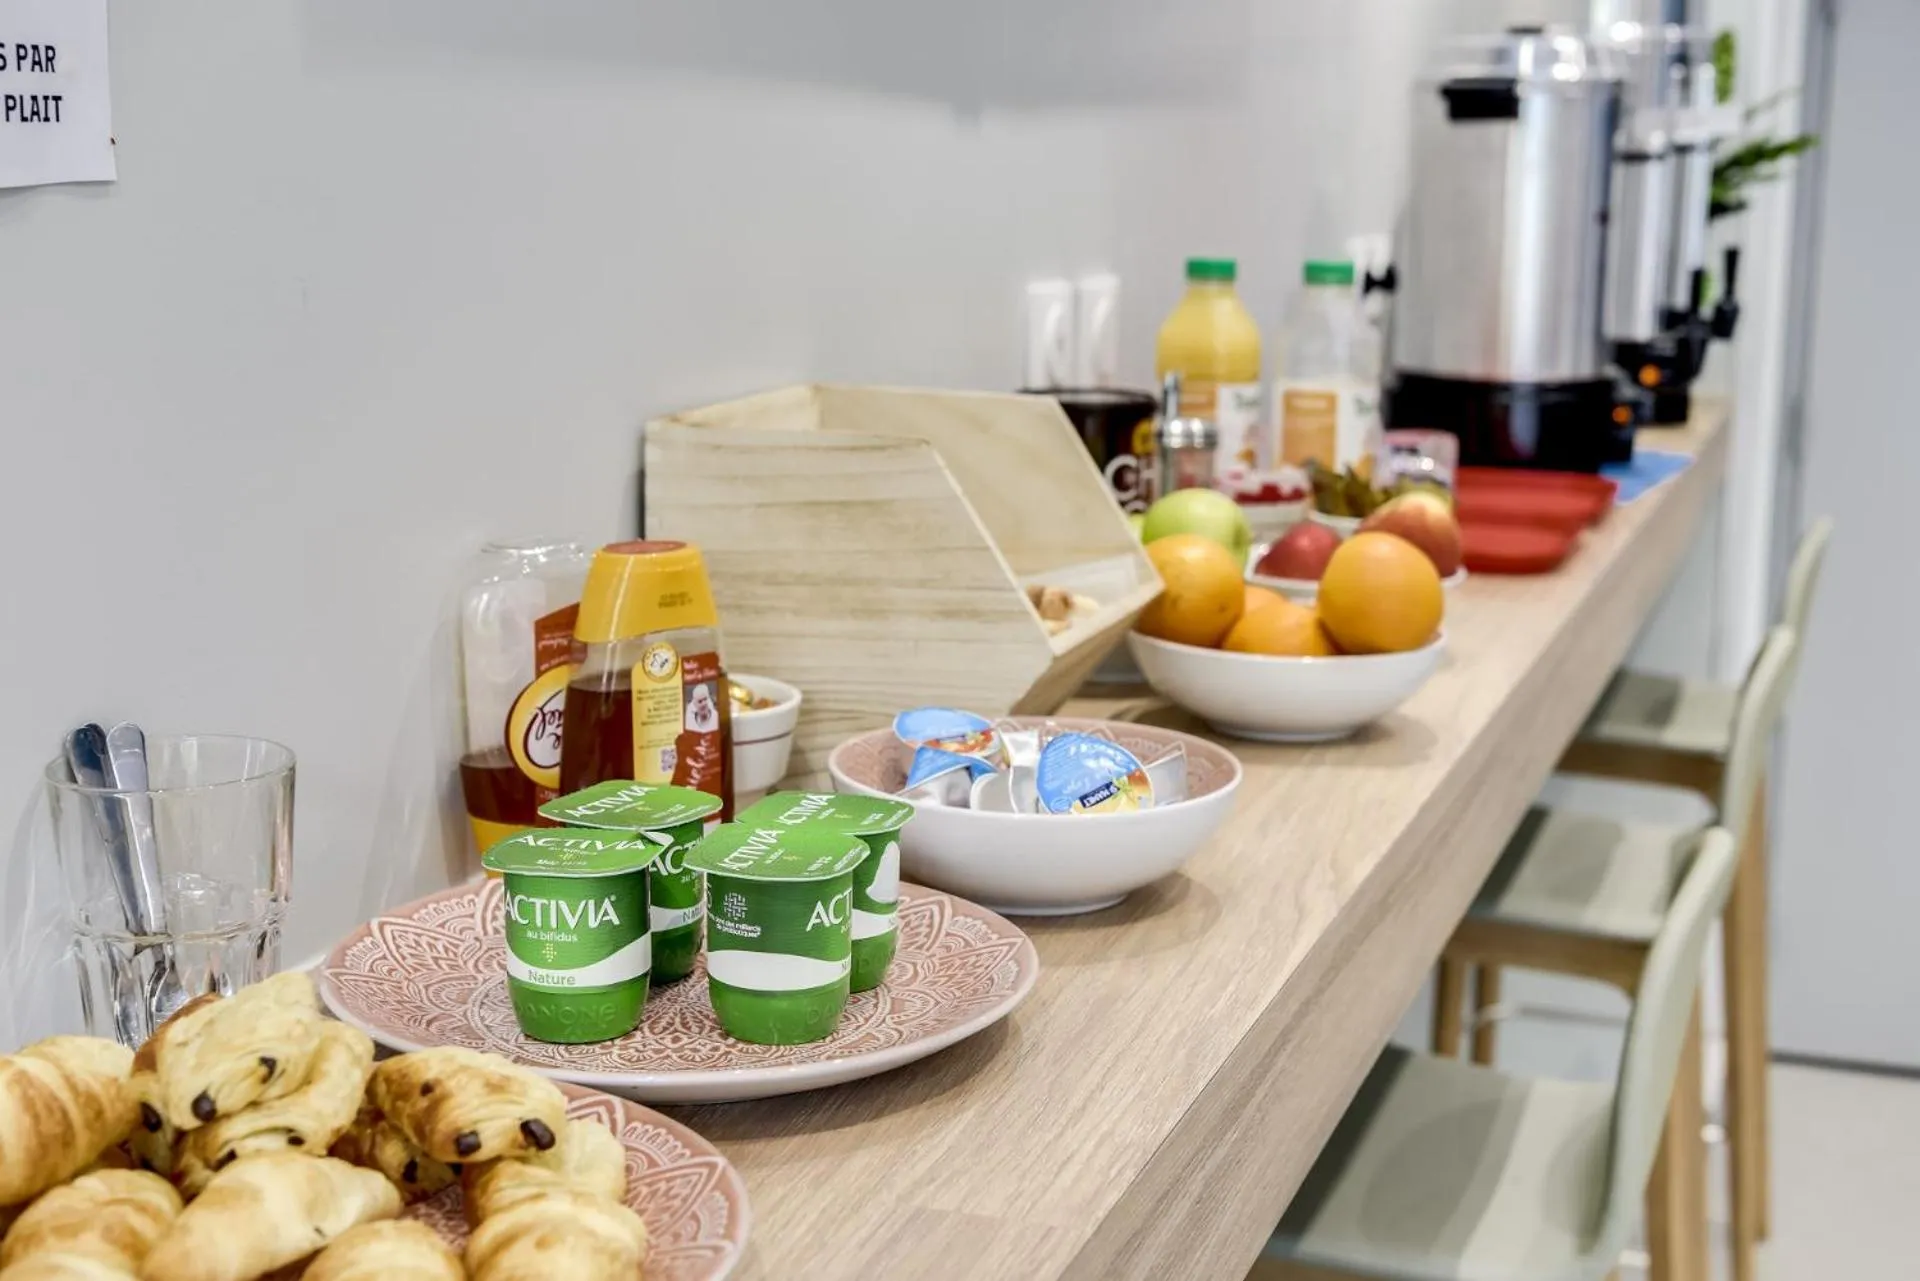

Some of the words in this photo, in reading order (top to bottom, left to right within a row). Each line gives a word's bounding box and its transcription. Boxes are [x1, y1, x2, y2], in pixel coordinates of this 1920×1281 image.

[15, 43, 57, 73] PAR
[4, 94, 63, 122] PLAIT
[565, 786, 658, 818] ACTIVIA
[776, 793, 836, 825] ACTIVIA
[512, 834, 646, 851] ACTIVIA
[717, 827, 785, 871] ACTIVIA
[526, 930, 538, 940] au
[540, 930, 578, 942] bifidus
[527, 969, 577, 985] Nature
